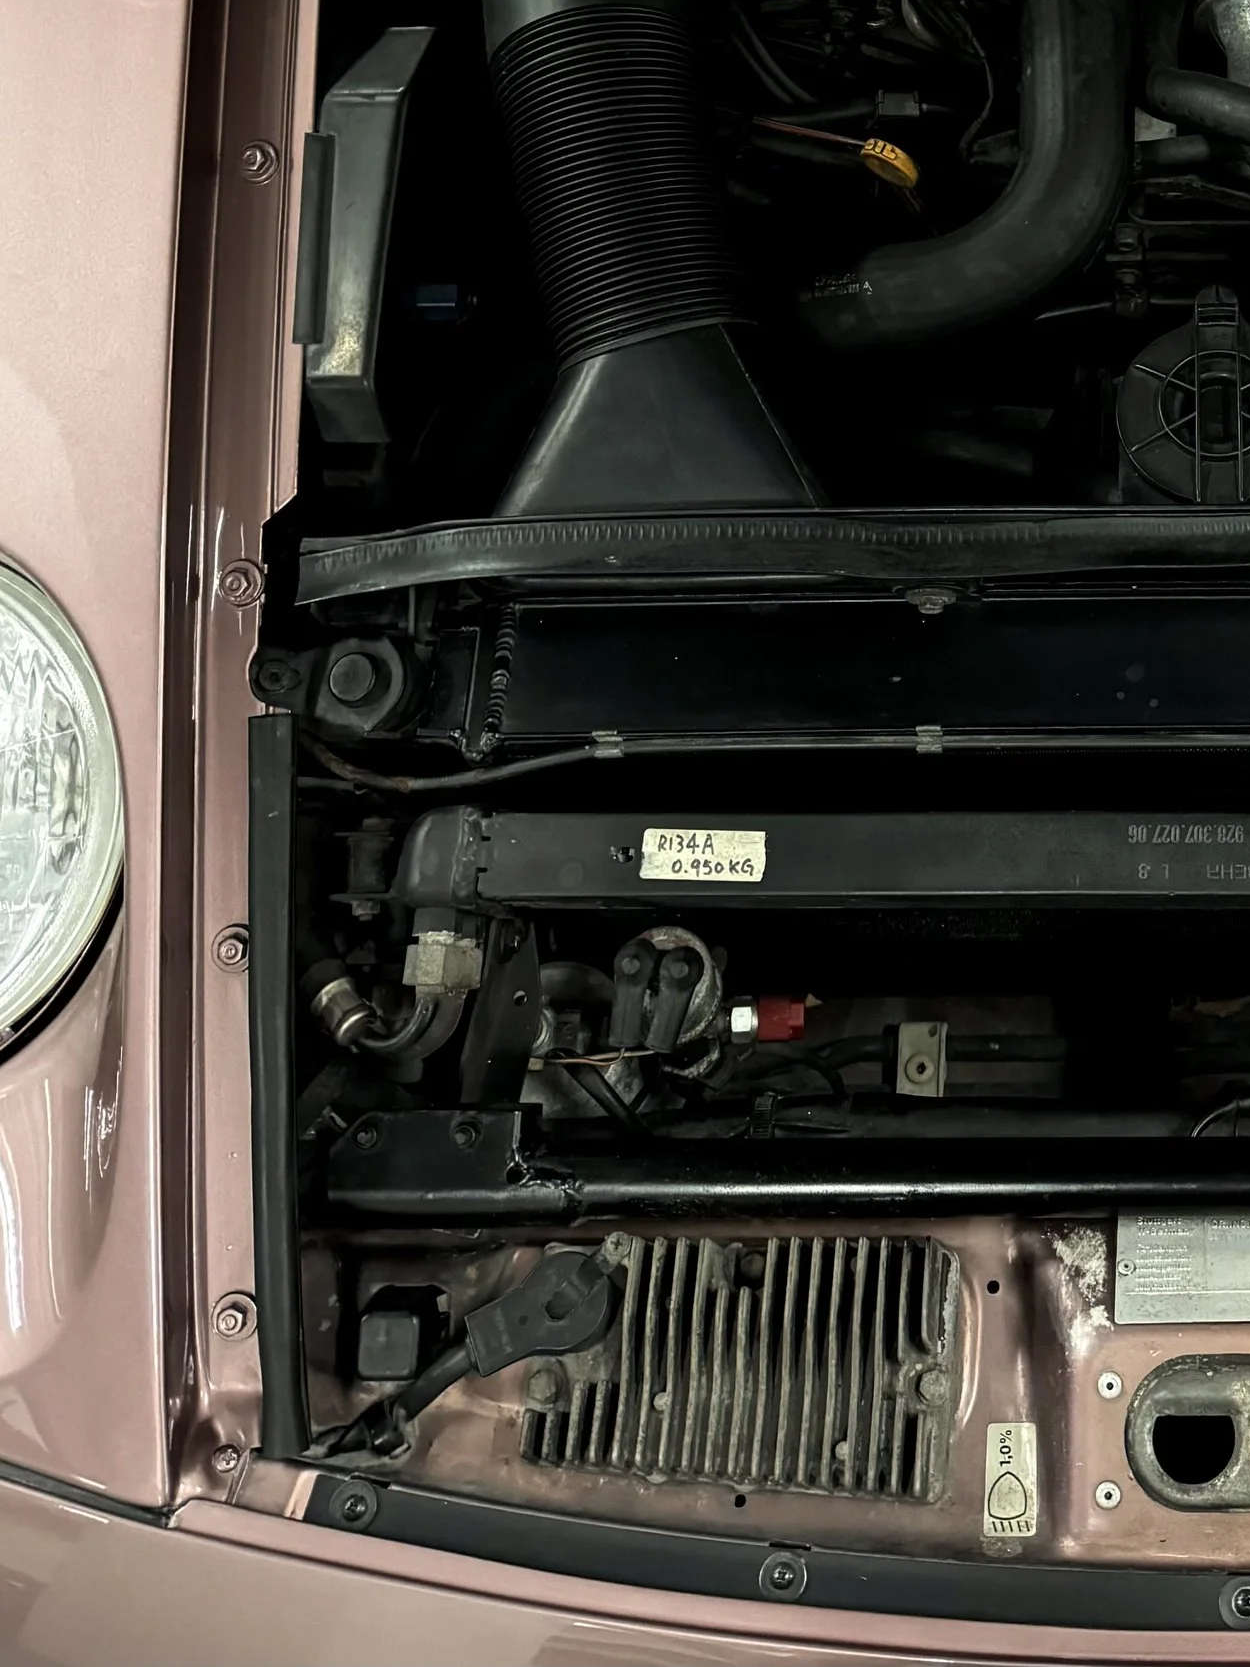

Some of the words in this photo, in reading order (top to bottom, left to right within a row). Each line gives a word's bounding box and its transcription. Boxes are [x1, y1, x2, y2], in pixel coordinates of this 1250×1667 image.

[658, 832, 714, 855] R134A
[1128, 824, 1244, 844] 928.307.027.06
[728, 858, 755, 876] KG
[999, 1429, 1013, 1467] 1,0%
